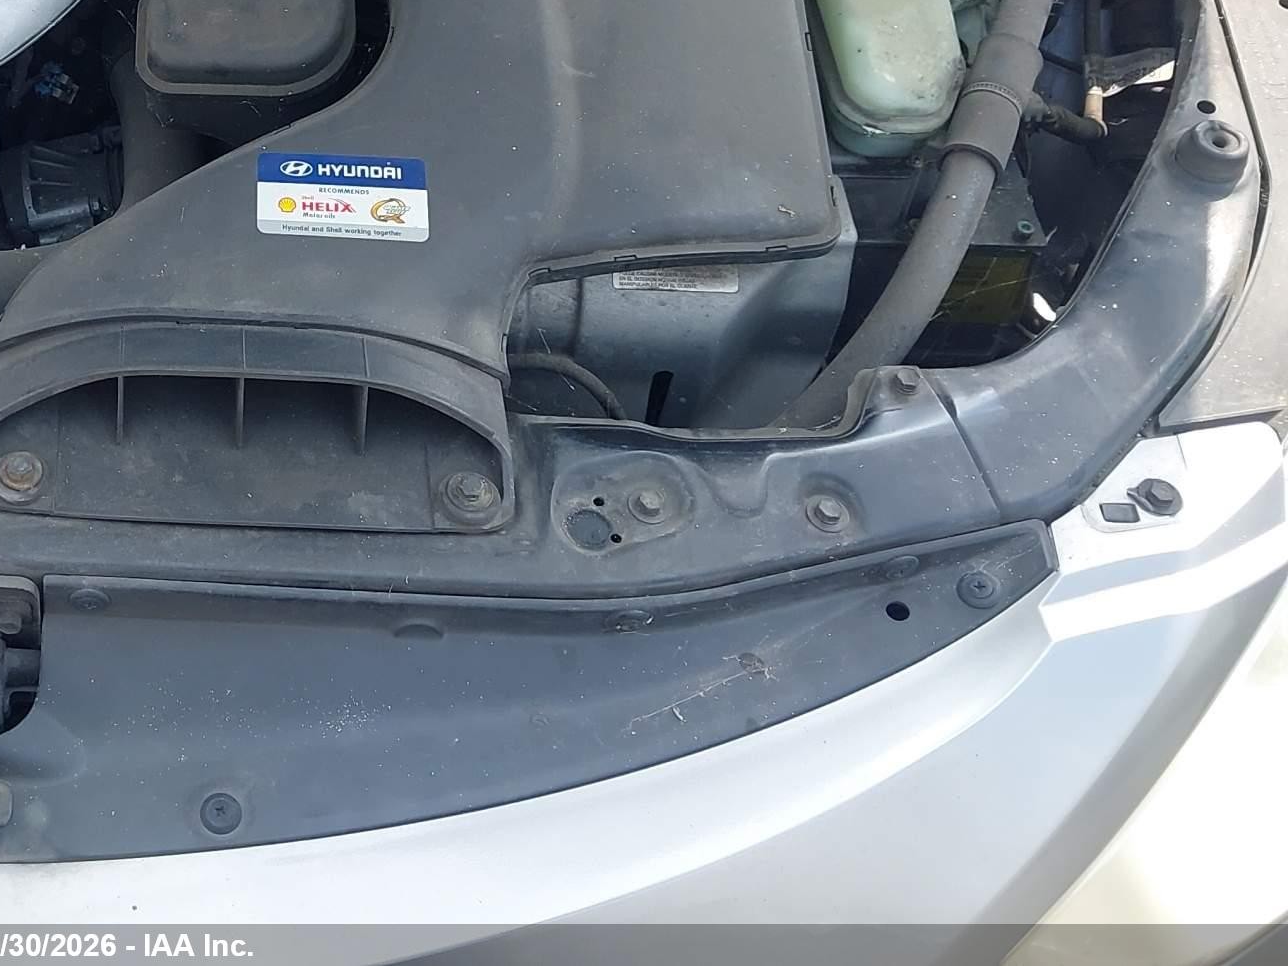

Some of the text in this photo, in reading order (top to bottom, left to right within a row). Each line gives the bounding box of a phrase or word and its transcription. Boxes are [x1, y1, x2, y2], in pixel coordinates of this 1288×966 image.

[318, 164, 402, 179] HYUNDAI
[318, 187, 370, 195] RECOMMENDS
[302, 201, 354, 213] HELIX
[282, 224, 309, 233] Hyundai
[312, 225, 324, 233] and
[345, 227, 371, 236] working
[373, 229, 402, 237] together
